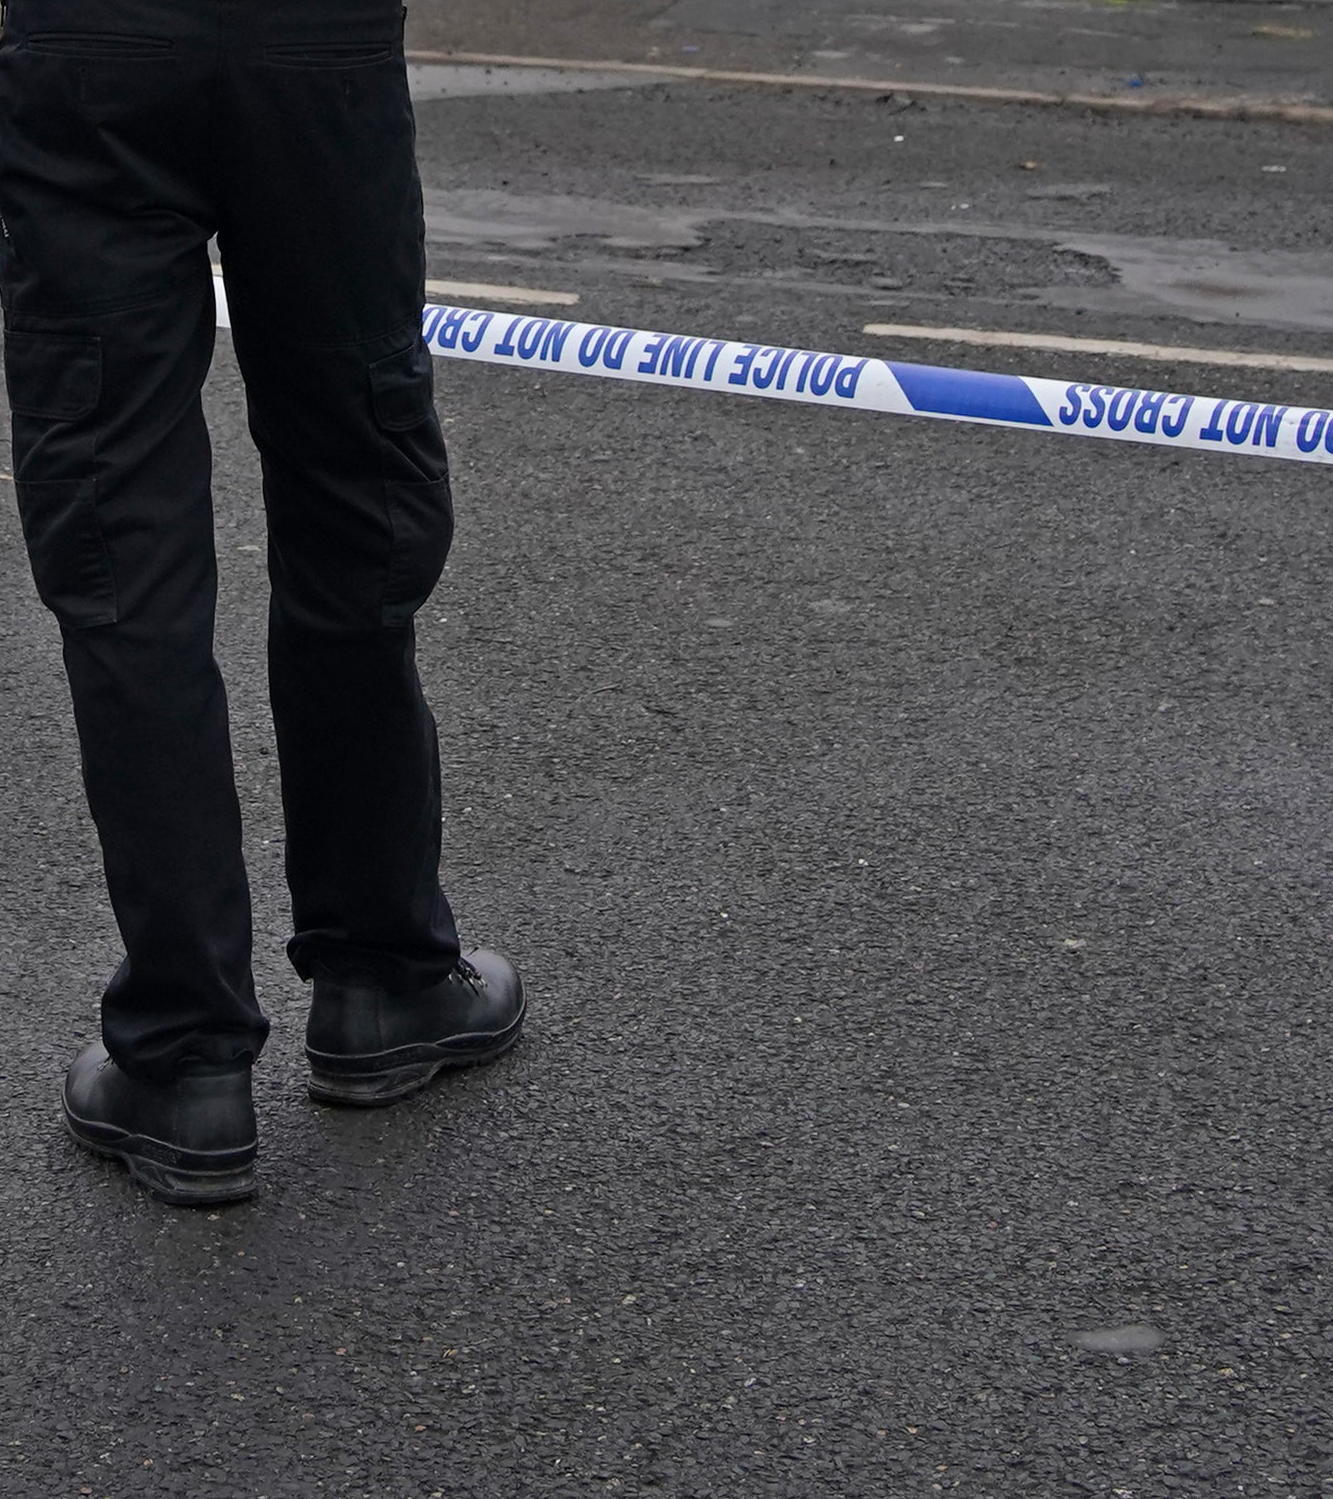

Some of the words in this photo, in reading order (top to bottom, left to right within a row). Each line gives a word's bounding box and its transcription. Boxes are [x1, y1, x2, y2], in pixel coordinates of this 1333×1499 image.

[493, 317, 575, 363] NOT
[576, 328, 635, 371] DO
[636, 335, 724, 382] LINE
[727, 344, 867, 399] POLICE
[1058, 384, 1194, 438] CROSS
[1198, 400, 1287, 449] NOT
